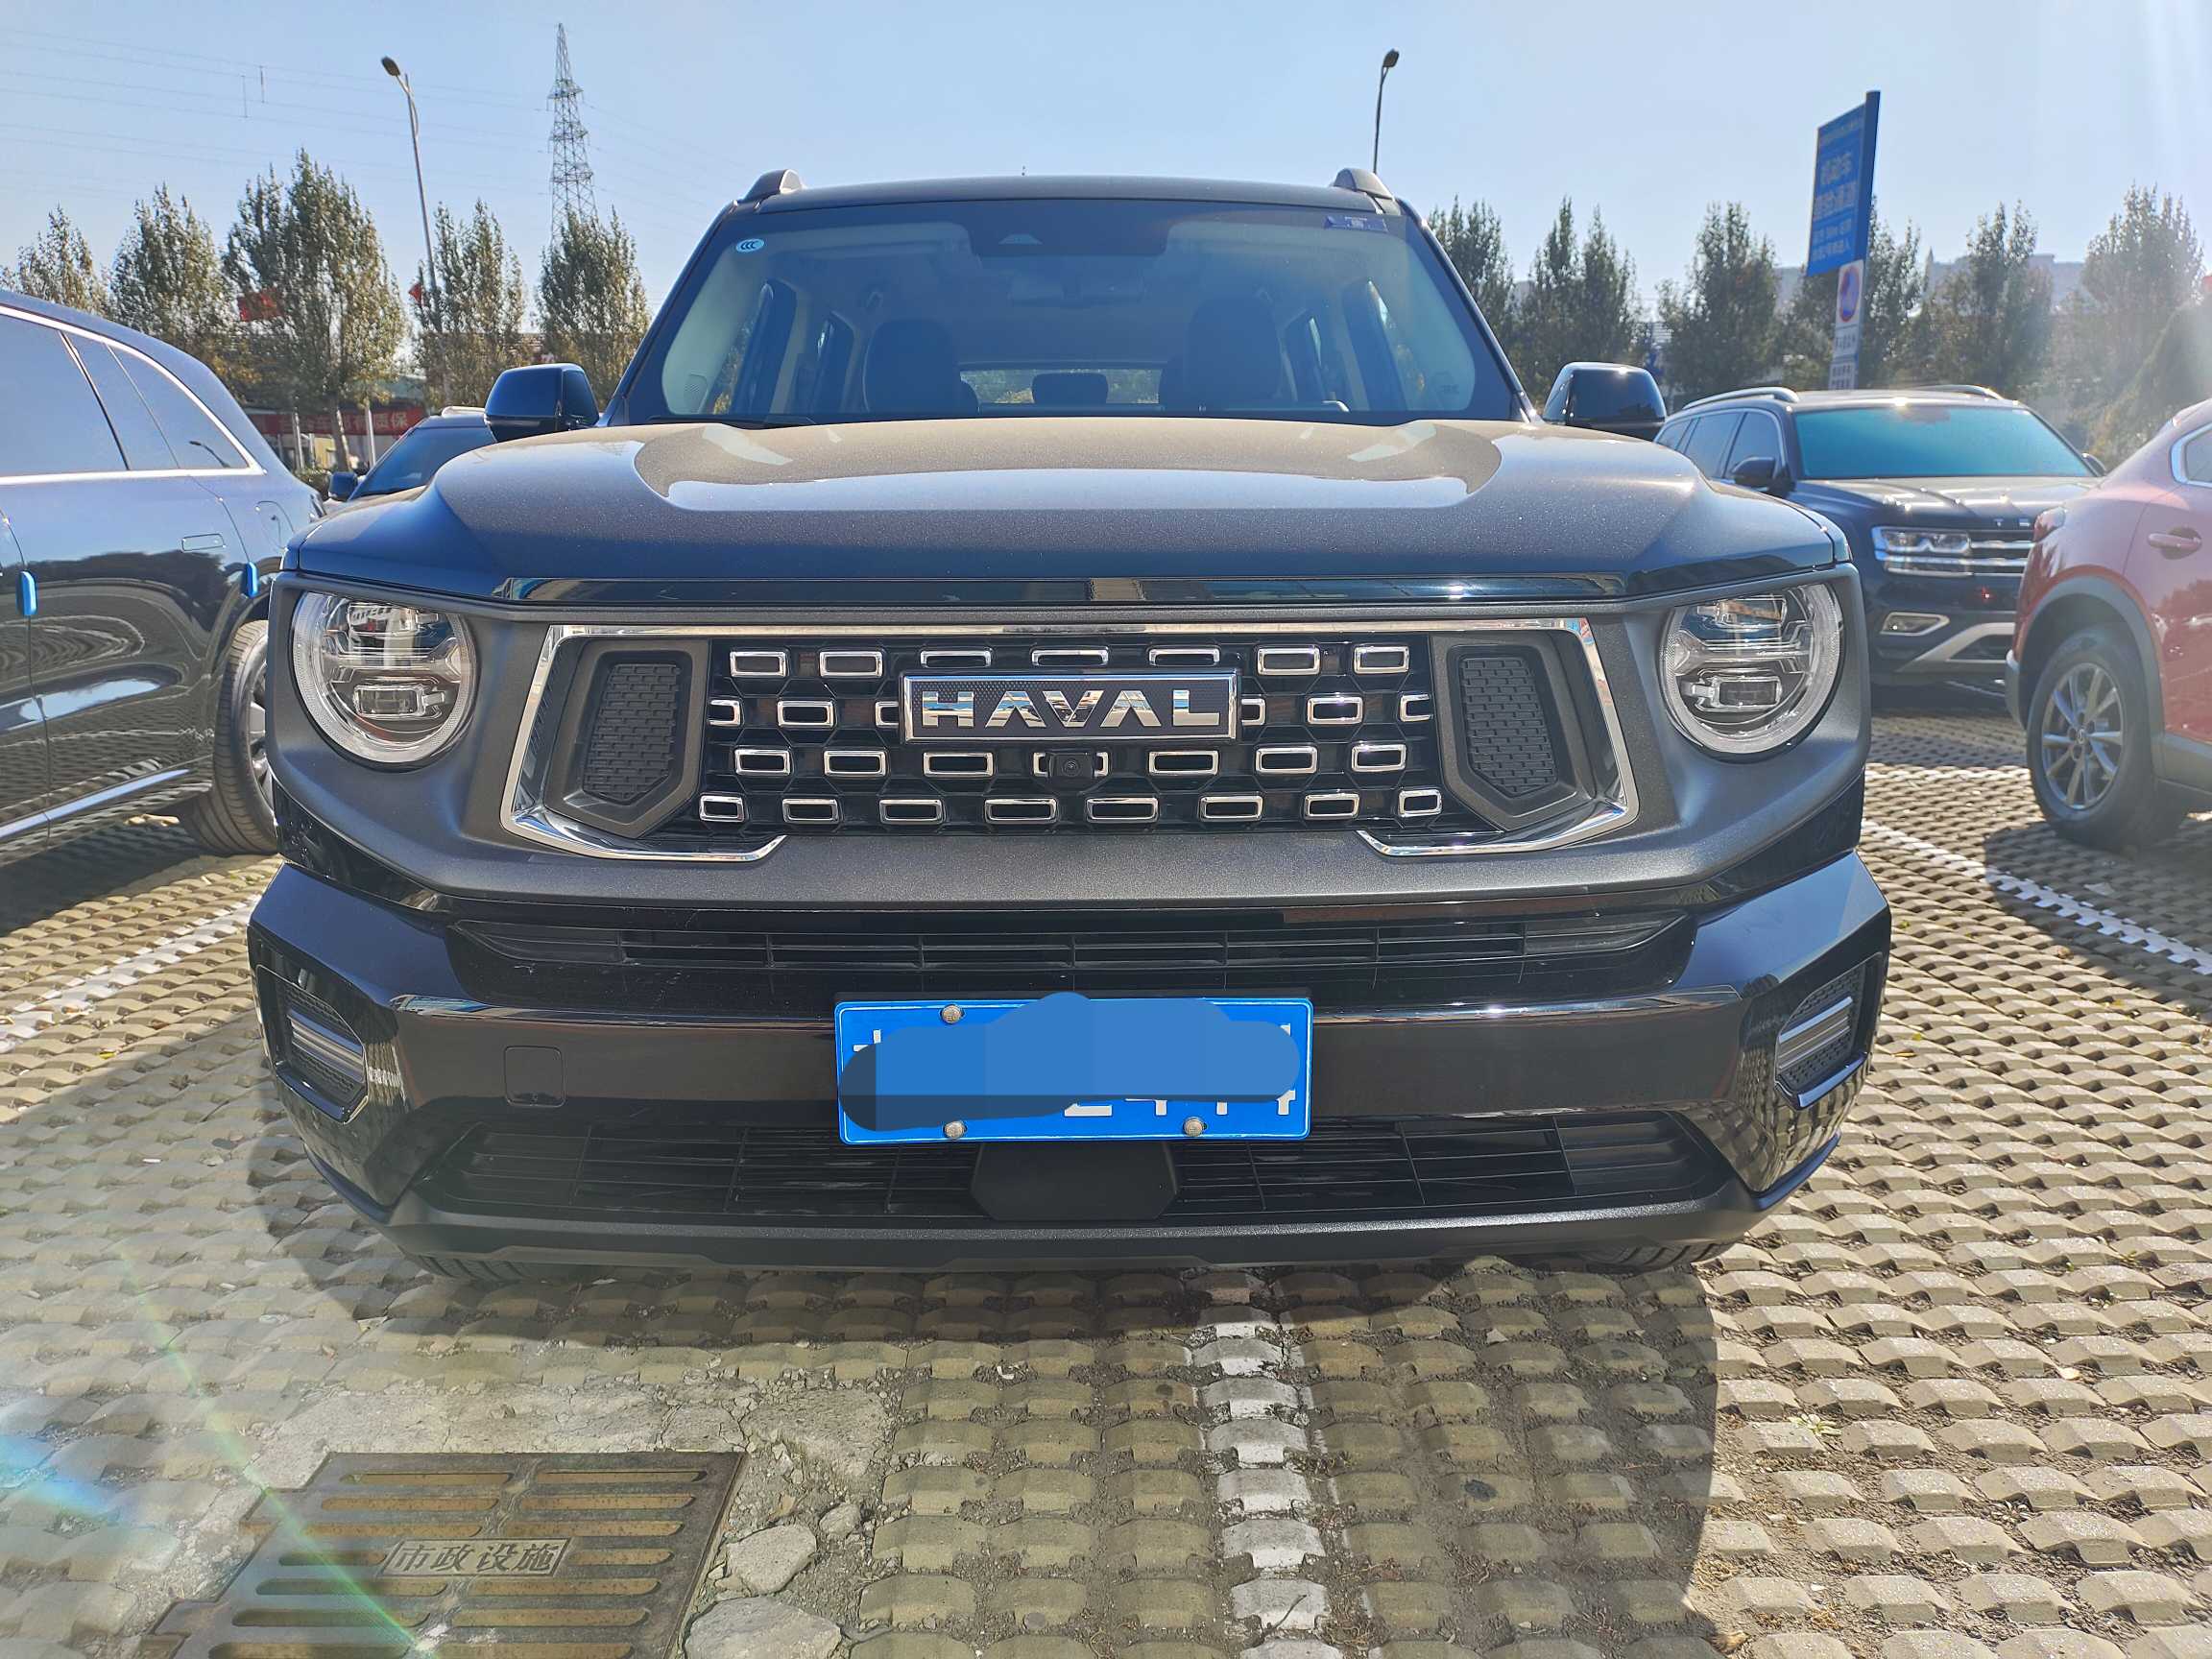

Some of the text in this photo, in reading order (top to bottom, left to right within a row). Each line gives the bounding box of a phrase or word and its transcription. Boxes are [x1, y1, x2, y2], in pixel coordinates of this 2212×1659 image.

[921, 689, 1220, 727] HAVAL
[394, 1543, 560, 1572] 市政设施
